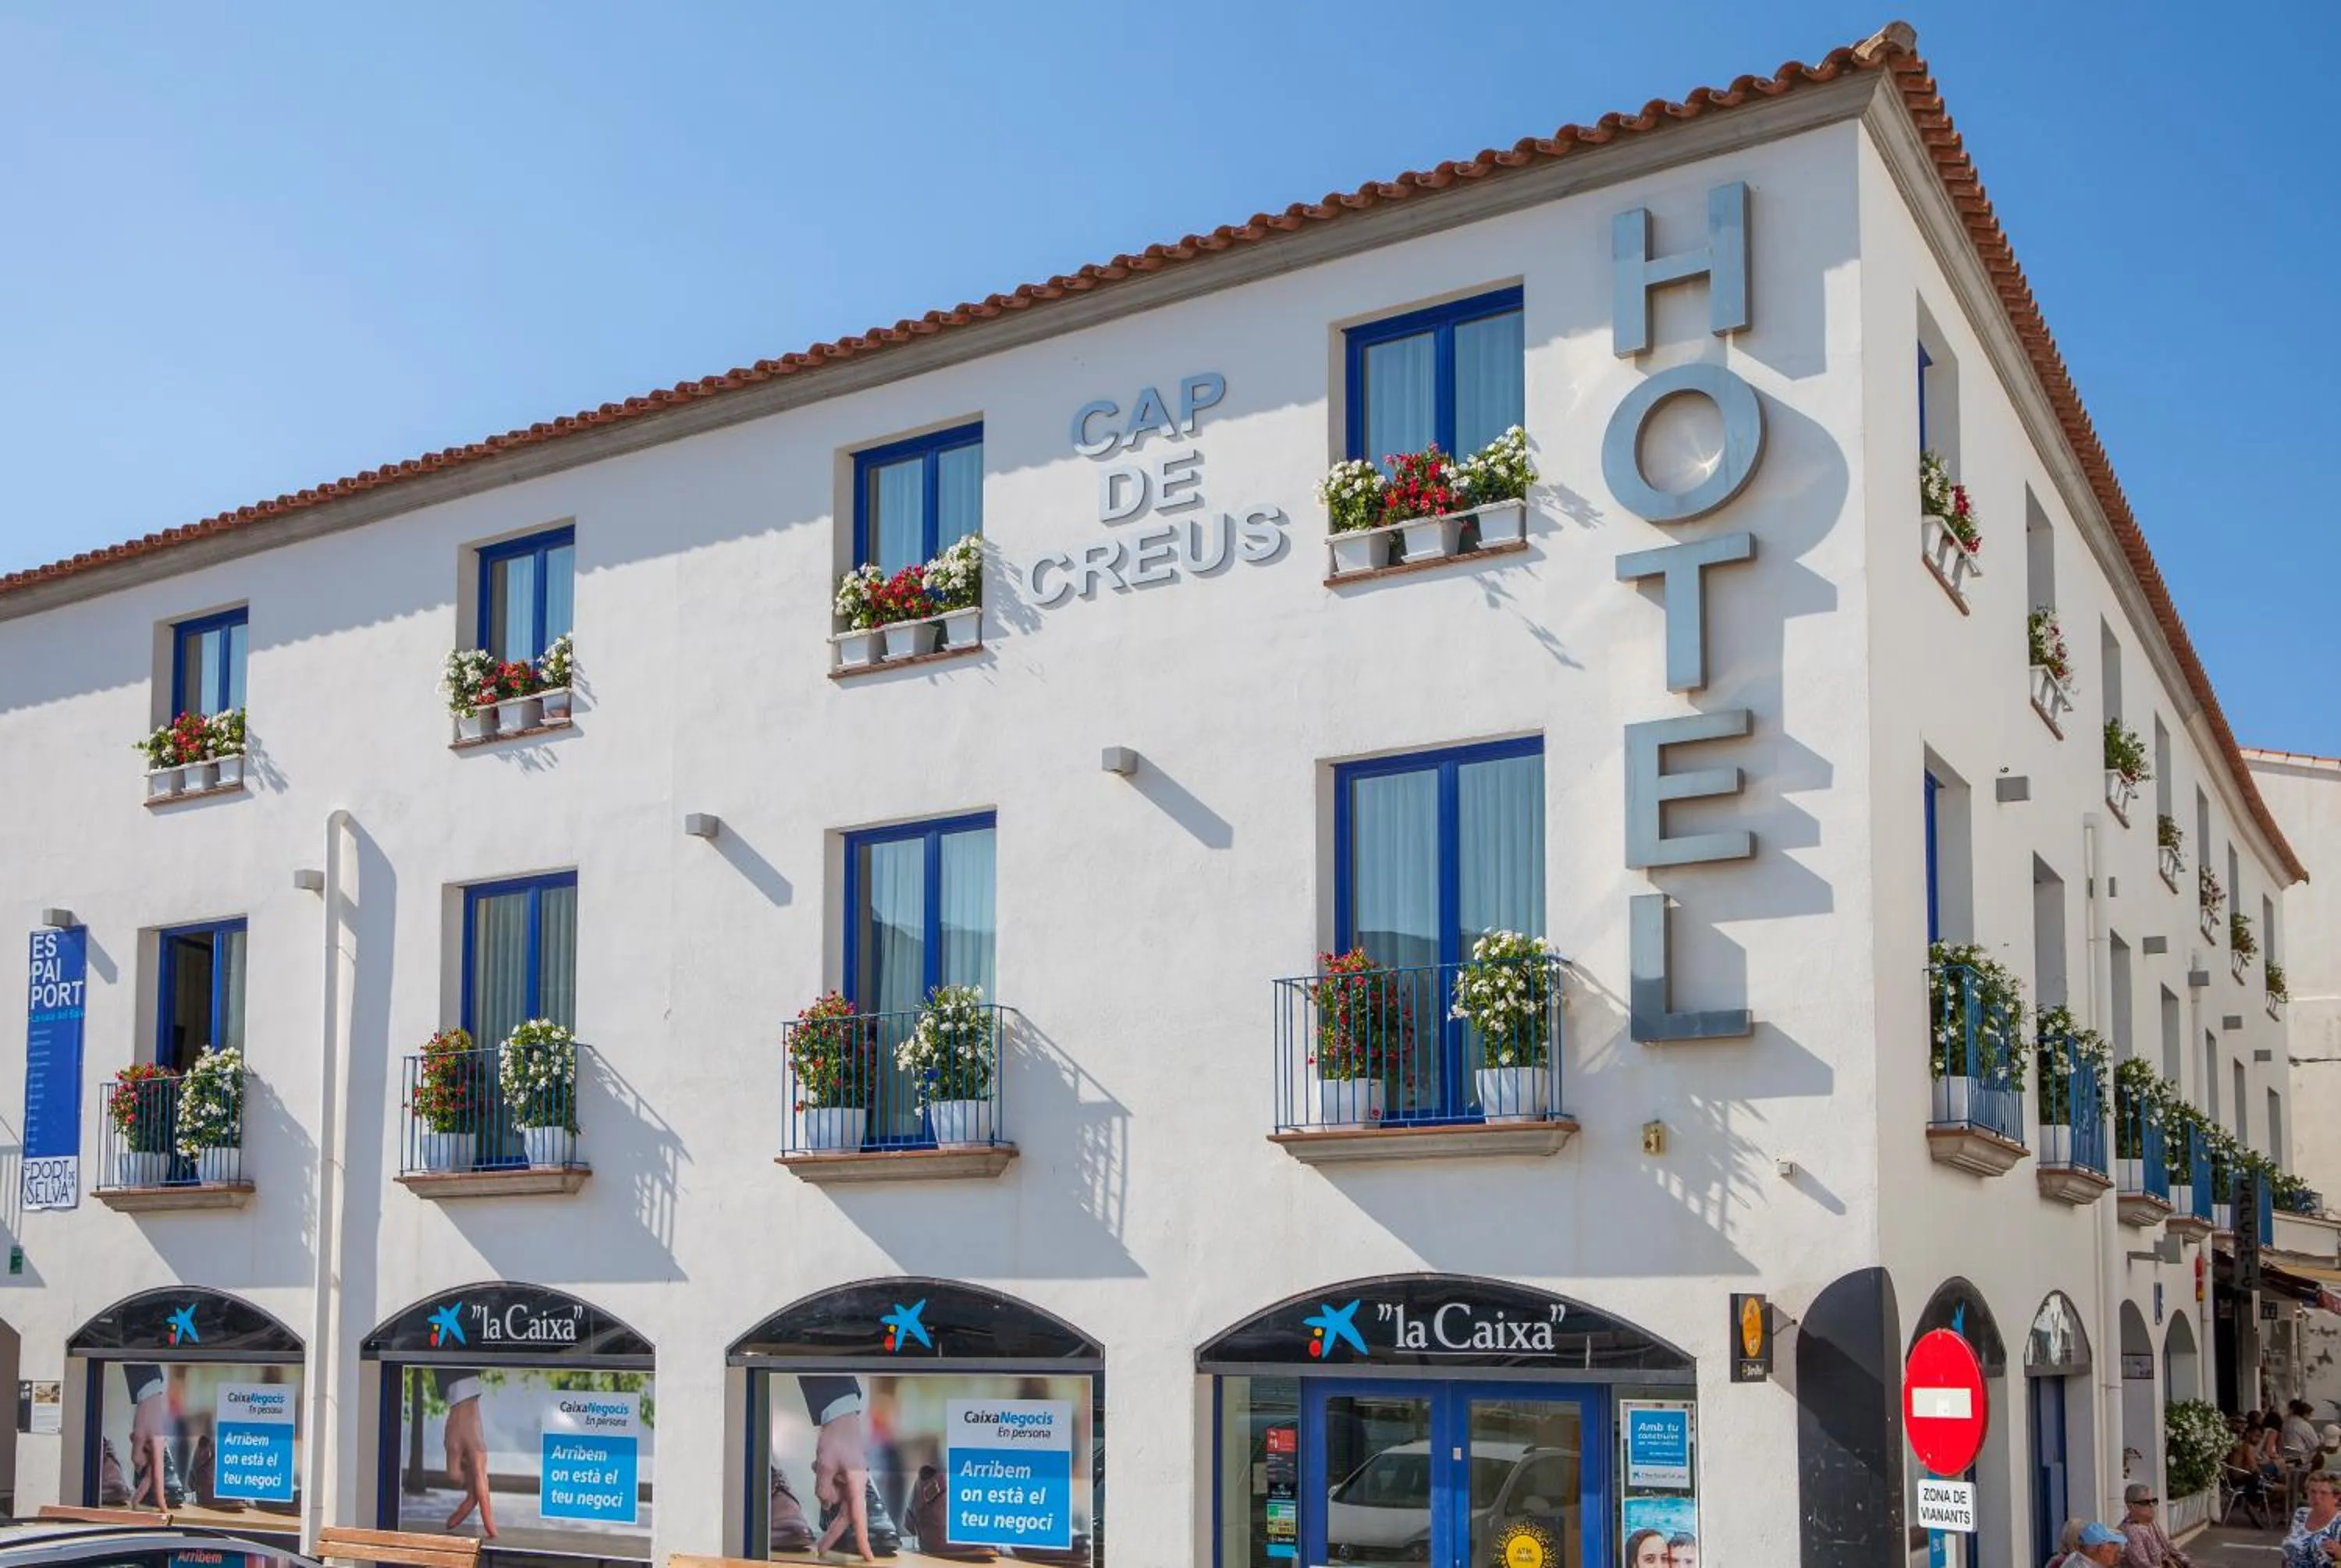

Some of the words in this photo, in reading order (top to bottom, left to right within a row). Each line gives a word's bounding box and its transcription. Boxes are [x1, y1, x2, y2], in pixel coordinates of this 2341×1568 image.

[1071, 372, 1226, 456] CAP
[1099, 449, 1198, 523] DE
[1027, 503, 1284, 605] CREUS
[1602, 181, 1765, 1045] HOTEL
[33, 934, 57, 959] ES
[32, 957, 62, 984] PAI
[31, 981, 83, 1010] PORT
[228, 1392, 285, 1404] CaixaNegocis
[559, 1400, 630, 1417] CaixaNegocis
[585, 1416, 595, 1425] En
[964, 1410, 1053, 1427] CaixaNegocis
[1638, 1422, 1664, 1431] Amb
[1668, 1422, 1678, 1431] tu
[225, 1432, 269, 1446] Arribem
[997, 1427, 1010, 1437] En
[1011, 1428, 1051, 1439] persona
[225, 1454, 237, 1464] on
[267, 1453, 278, 1467] el
[551, 1445, 607, 1461] Arribem
[552, 1470, 568, 1481] on
[573, 1468, 600, 1484] està
[605, 1469, 618, 1485] el
[961, 1460, 1031, 1479] Arribem
[224, 1471, 241, 1485] teu
[244, 1473, 281, 1489] negoci
[551, 1489, 573, 1504] teu
[577, 1492, 623, 1509] negoci
[961, 1488, 982, 1502] on
[987, 1486, 1023, 1504] està
[1028, 1487, 1046, 1504] el
[1924, 1488, 1951, 1502] ZONA
[1953, 1490, 1966, 1504] DE
[961, 1510, 988, 1527] teu
[993, 1513, 1053, 1534] negoci
[1921, 1507, 1970, 1524] VIANANTS
[177, 1548, 222, 1564] Arribem
